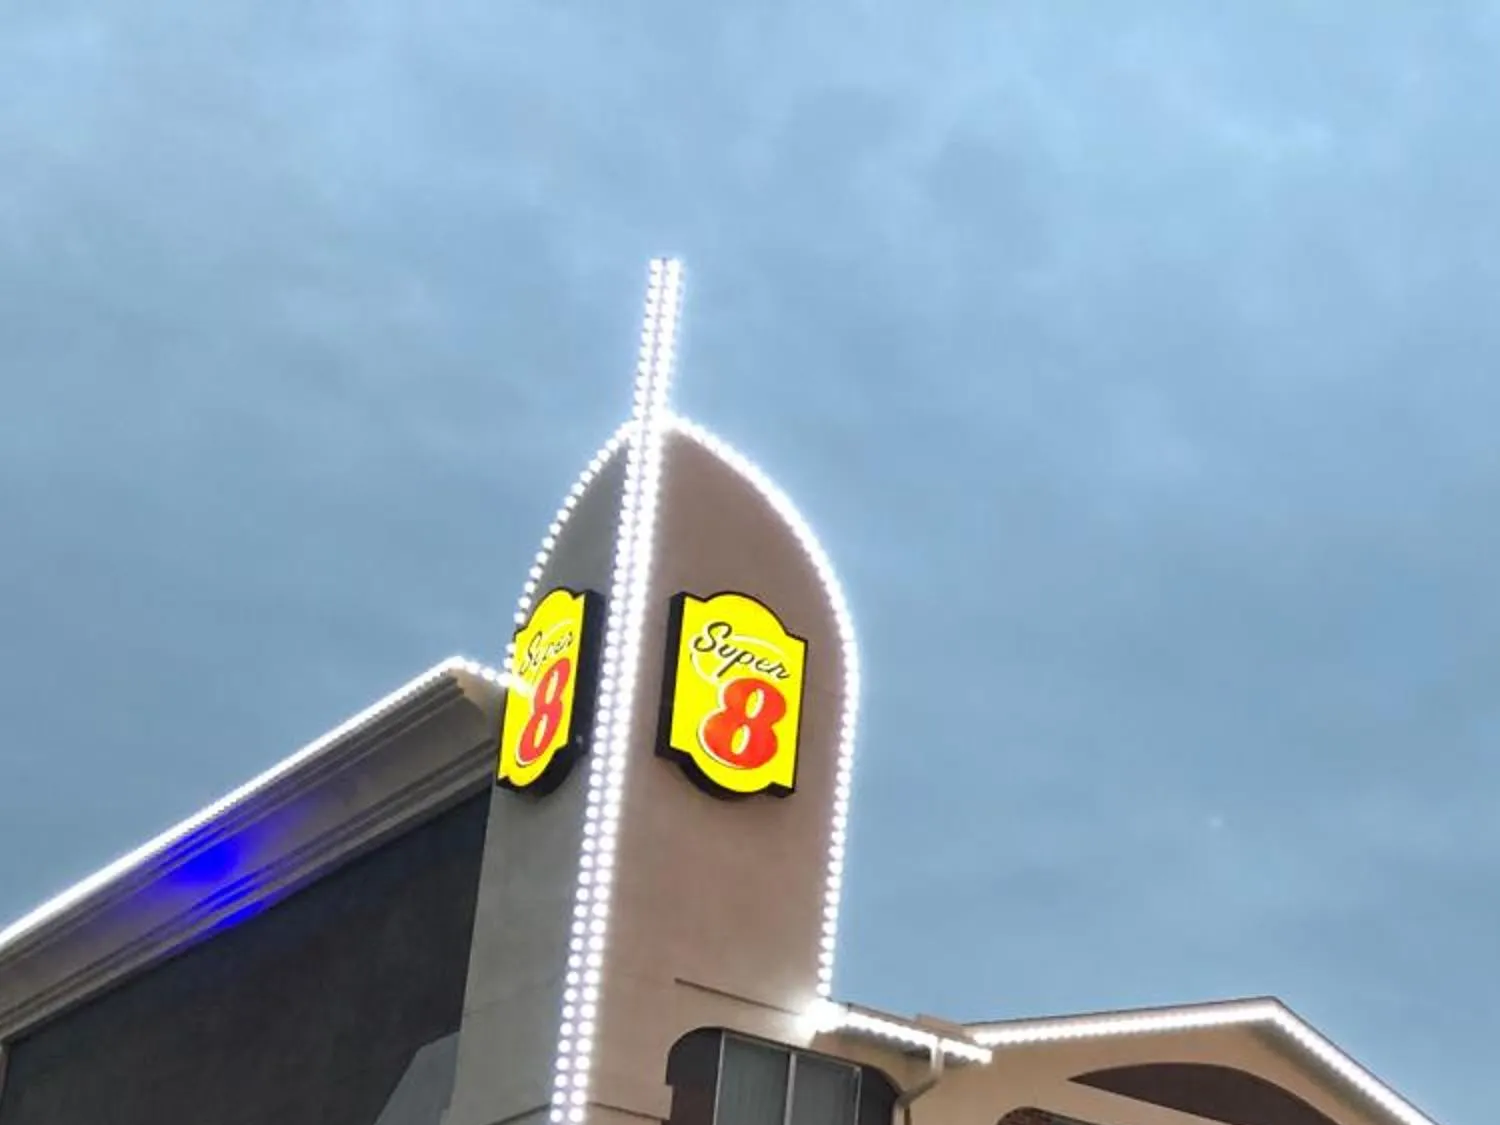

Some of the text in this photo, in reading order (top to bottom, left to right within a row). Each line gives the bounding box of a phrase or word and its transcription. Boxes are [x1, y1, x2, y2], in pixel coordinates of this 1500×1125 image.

[694, 620, 791, 680] Super
[516, 657, 571, 766] 8
[699, 677, 787, 770] 8
